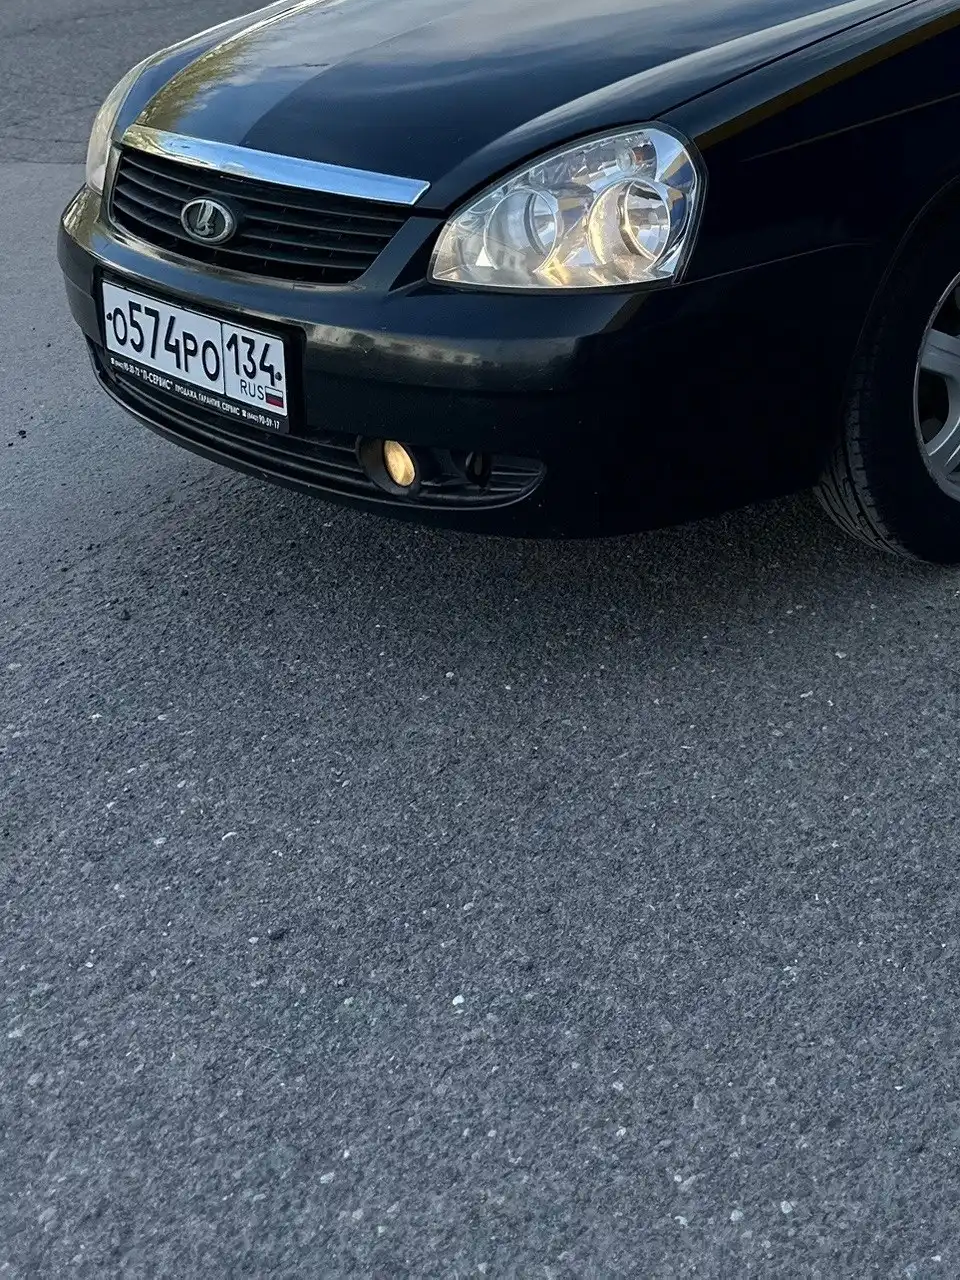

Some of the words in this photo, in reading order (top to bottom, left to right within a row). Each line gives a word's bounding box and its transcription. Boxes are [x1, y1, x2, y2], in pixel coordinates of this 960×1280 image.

[112, 300, 220, 382] О574РО
[226, 332, 275, 387] 134
[239, 378, 265, 401] RUS
